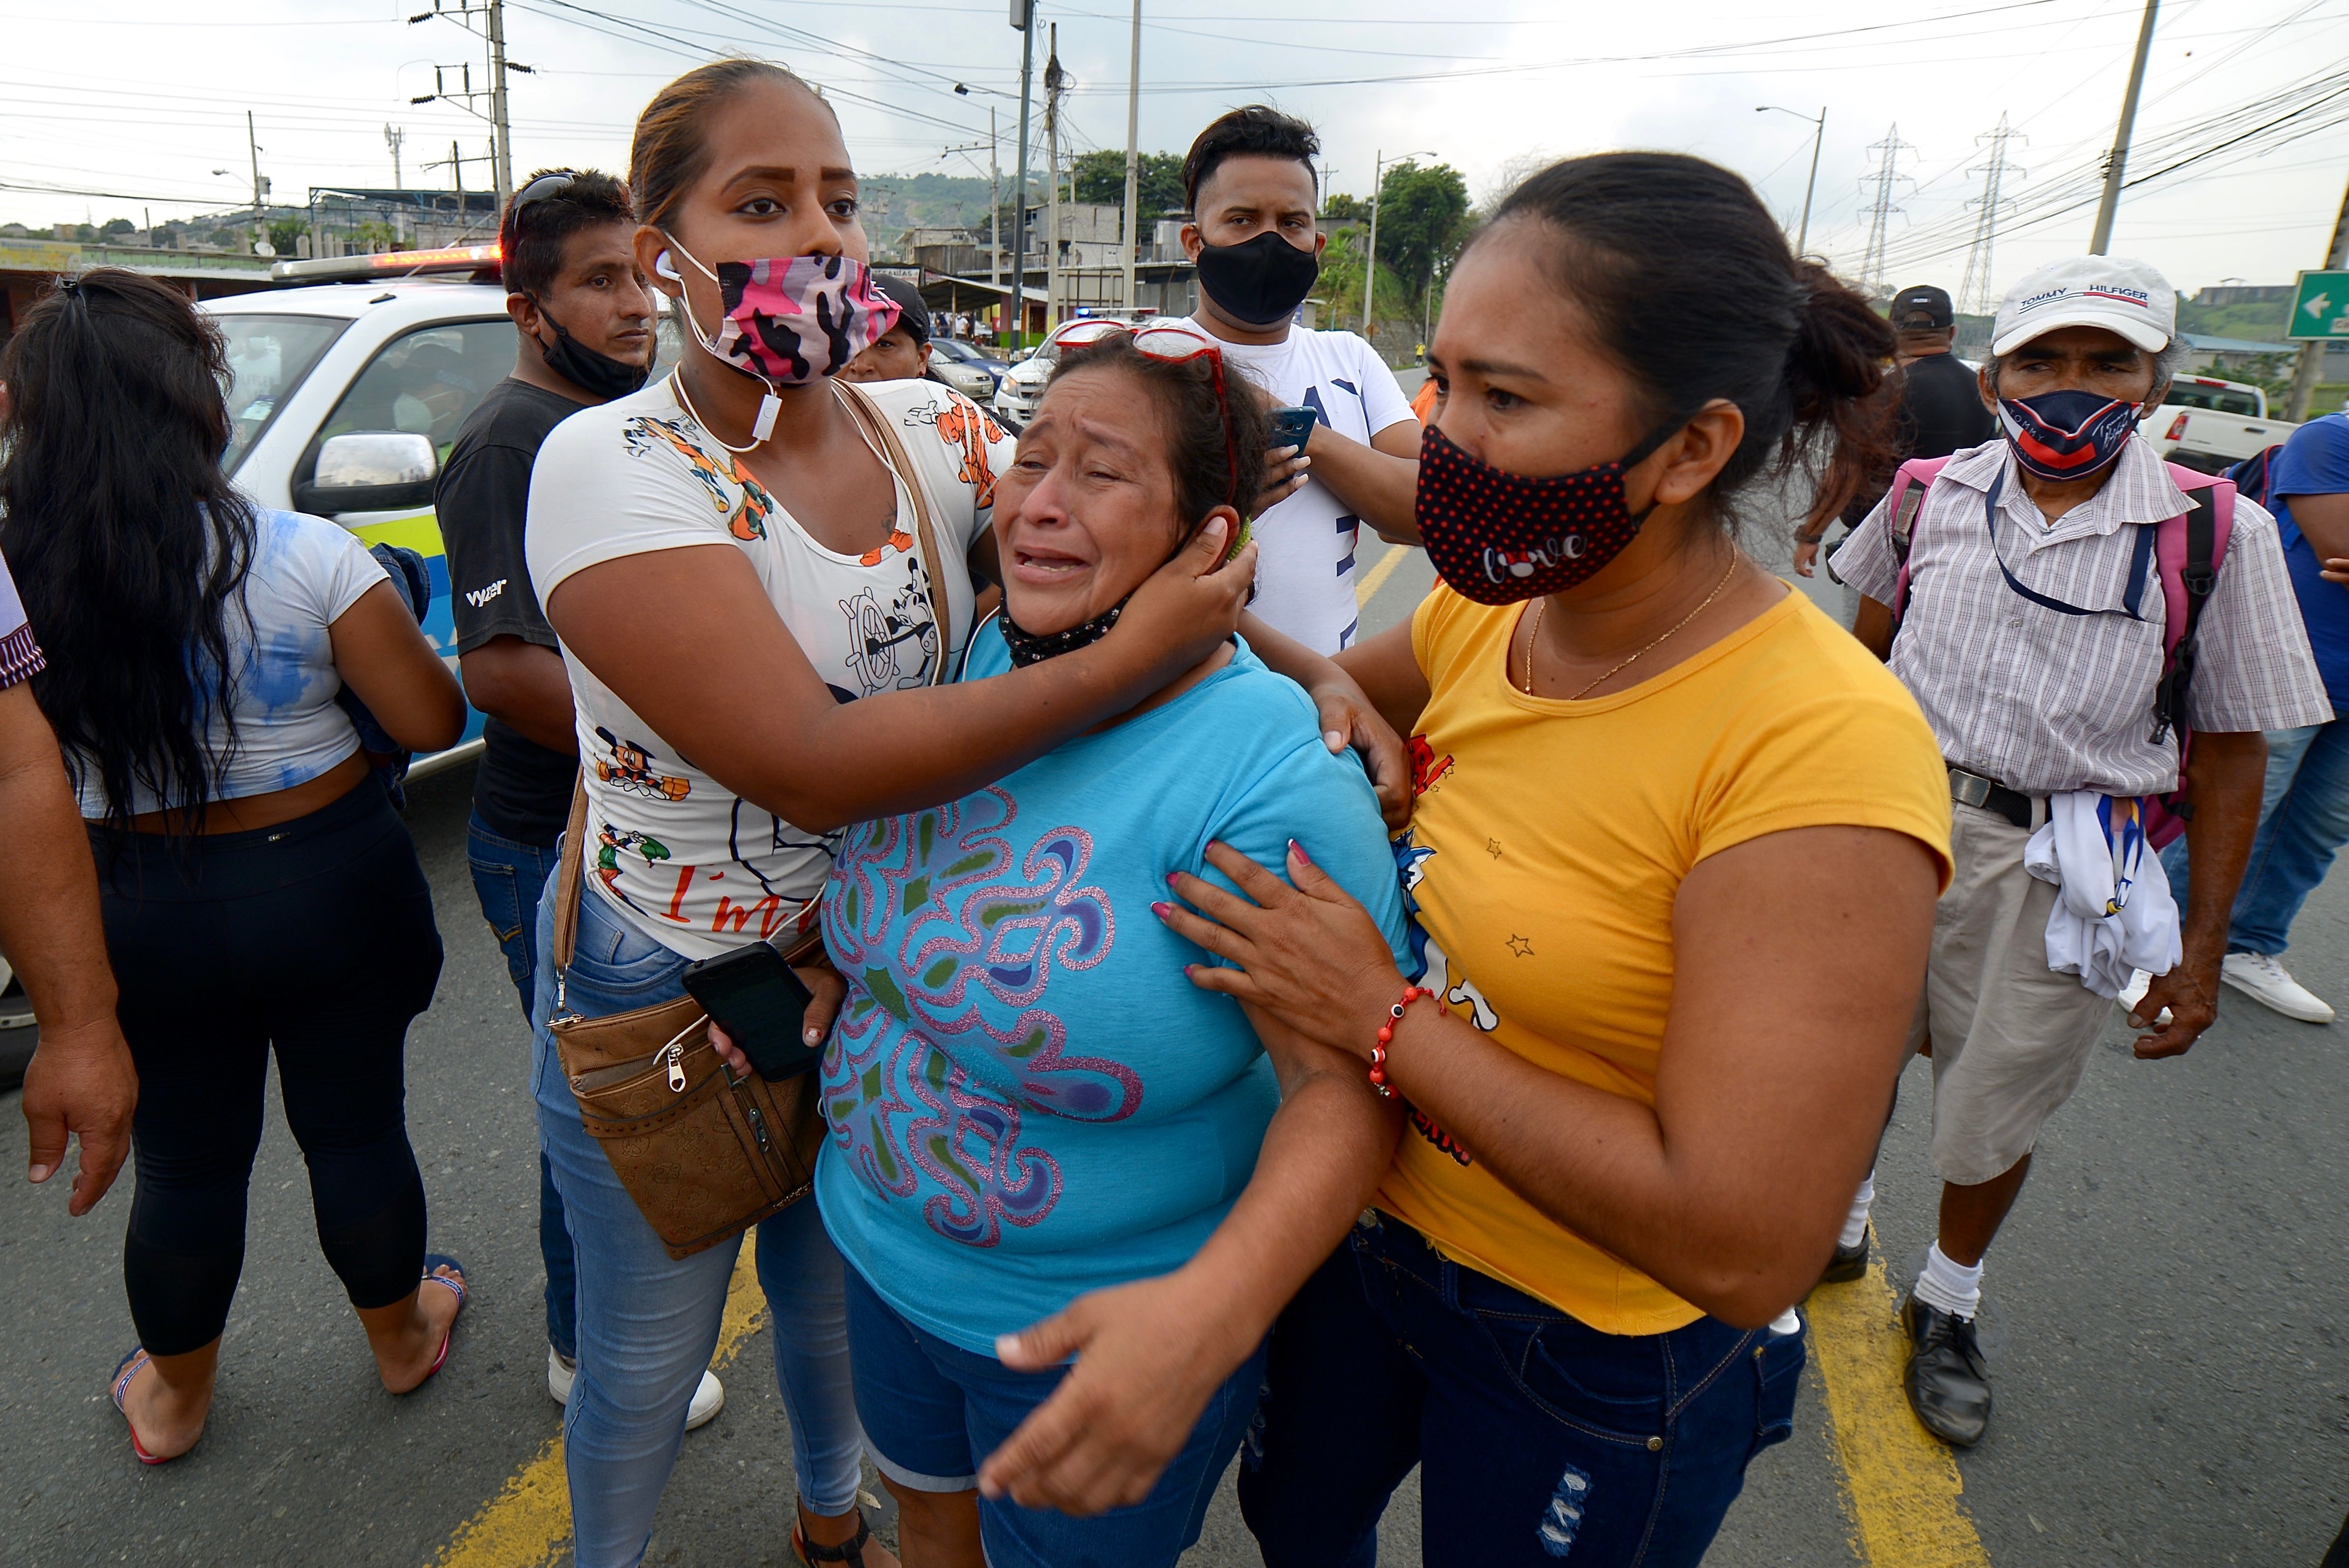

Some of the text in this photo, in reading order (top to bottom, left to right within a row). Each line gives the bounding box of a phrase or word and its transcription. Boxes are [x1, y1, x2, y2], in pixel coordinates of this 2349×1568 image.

[2021, 285, 2148, 307] TOMMY HILFIGER
[2009, 407, 2045, 442] TOMMY
[660, 864, 789, 939] I'm
